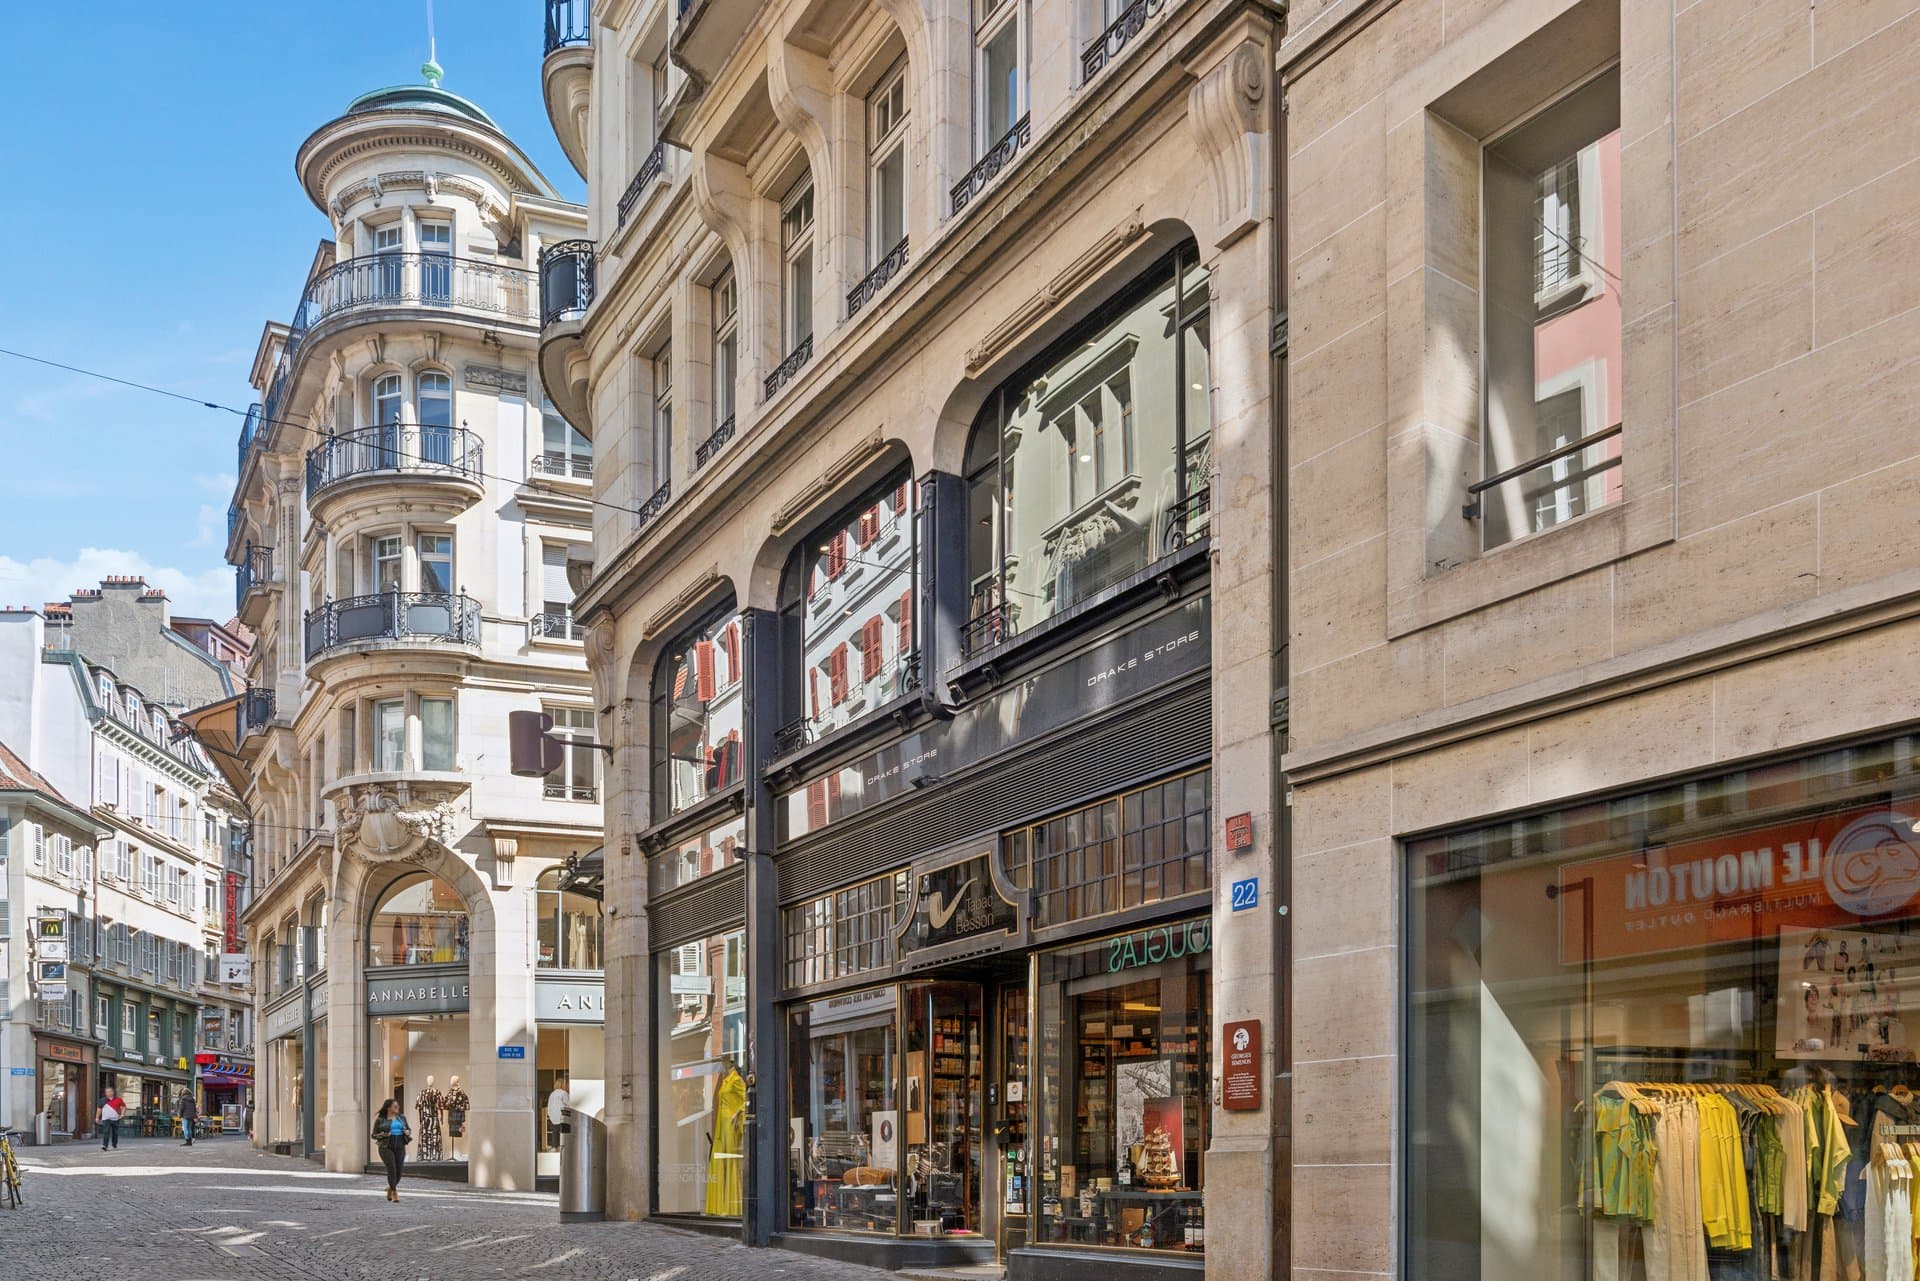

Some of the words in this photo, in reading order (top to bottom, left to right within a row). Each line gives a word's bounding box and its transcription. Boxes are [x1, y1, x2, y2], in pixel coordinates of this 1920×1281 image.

[1087, 658, 1137, 687] DRAKE
[1144, 630, 1199, 661] STORE
[867, 765, 899, 785] DRAKE
[902, 748, 937, 770] STORE
[966, 895, 993, 913] Tabac
[1234, 882, 1256, 907] 22
[955, 914, 994, 935] Besson
[369, 985, 469, 1002] ANNABELLE
[557, 993, 605, 1010] AN
